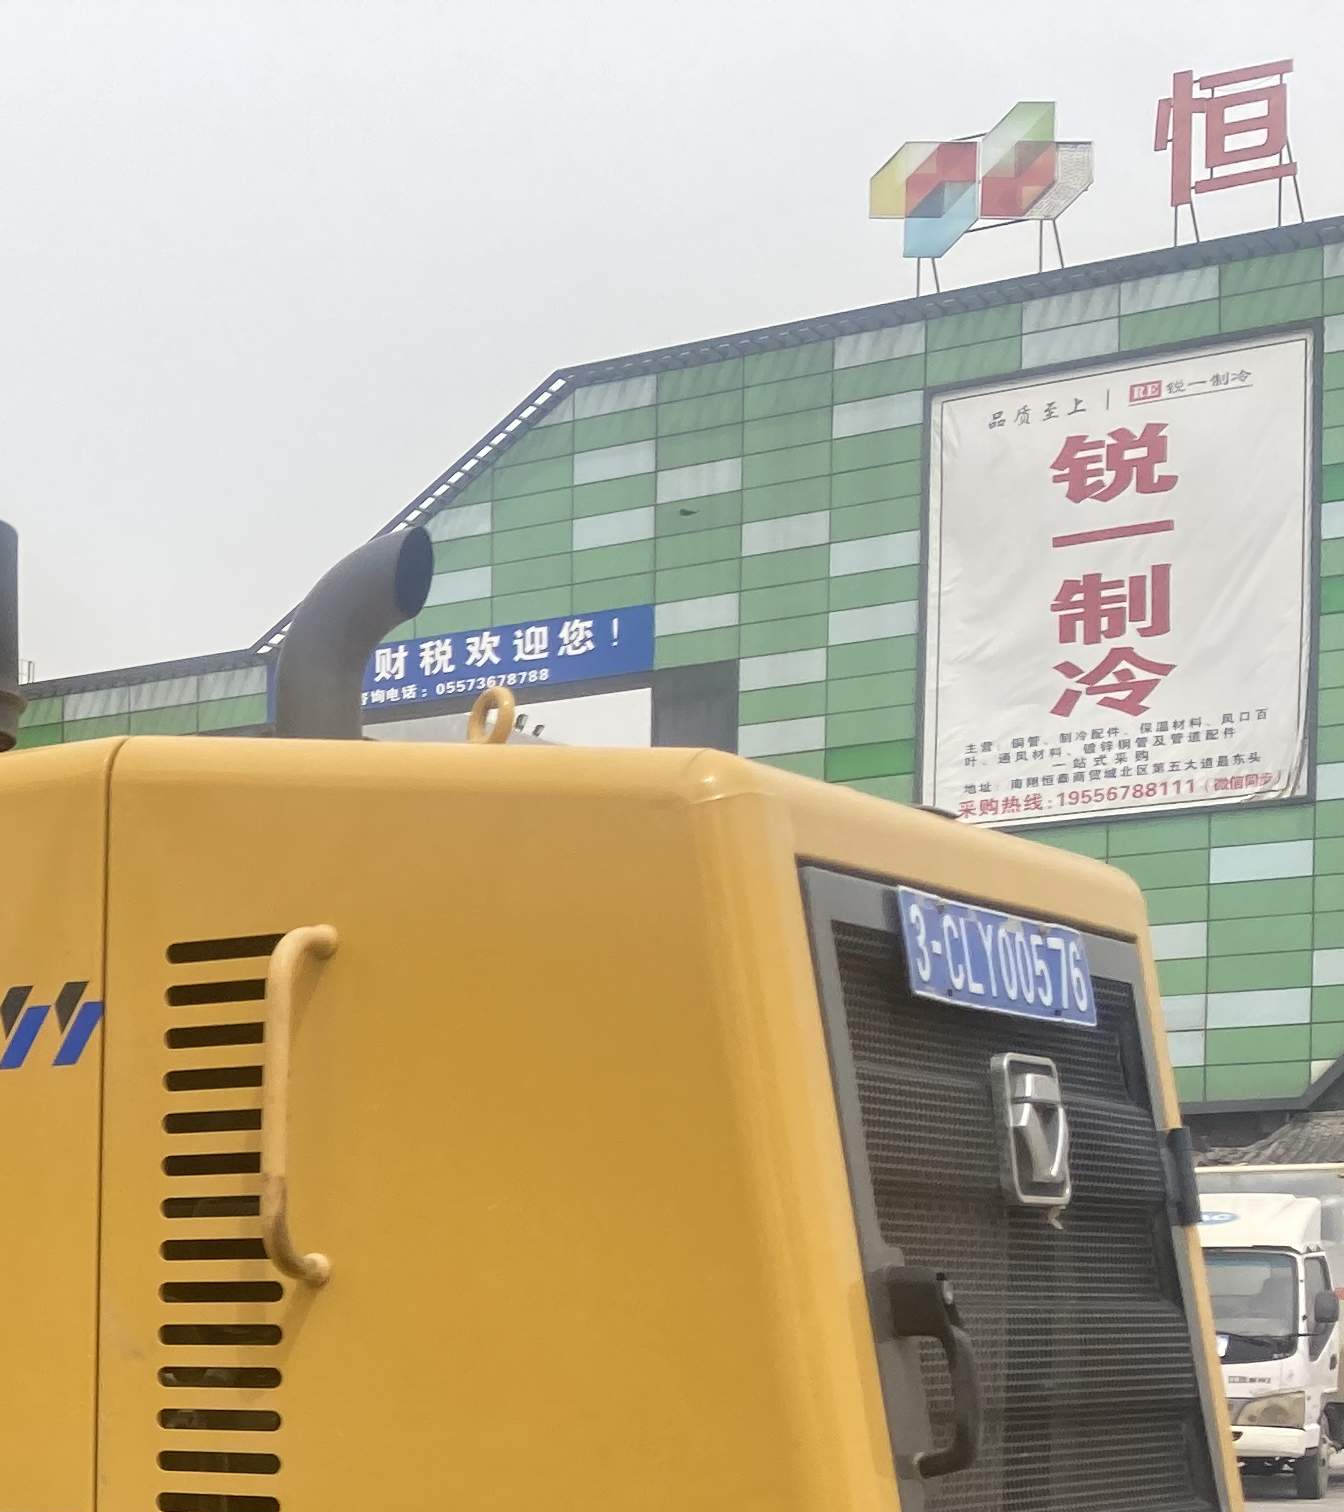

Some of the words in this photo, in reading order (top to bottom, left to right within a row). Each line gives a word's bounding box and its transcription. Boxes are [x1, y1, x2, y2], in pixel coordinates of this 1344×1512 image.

[1154, 59, 1297, 207] 恒
[988, 398, 1087, 430] 品质至上
[1166, 369, 1252, 395] 锐一制冷
[1050, 422, 1179, 718] 锐一制冷
[909, 903, 1088, 1012] 3-CLY00576
